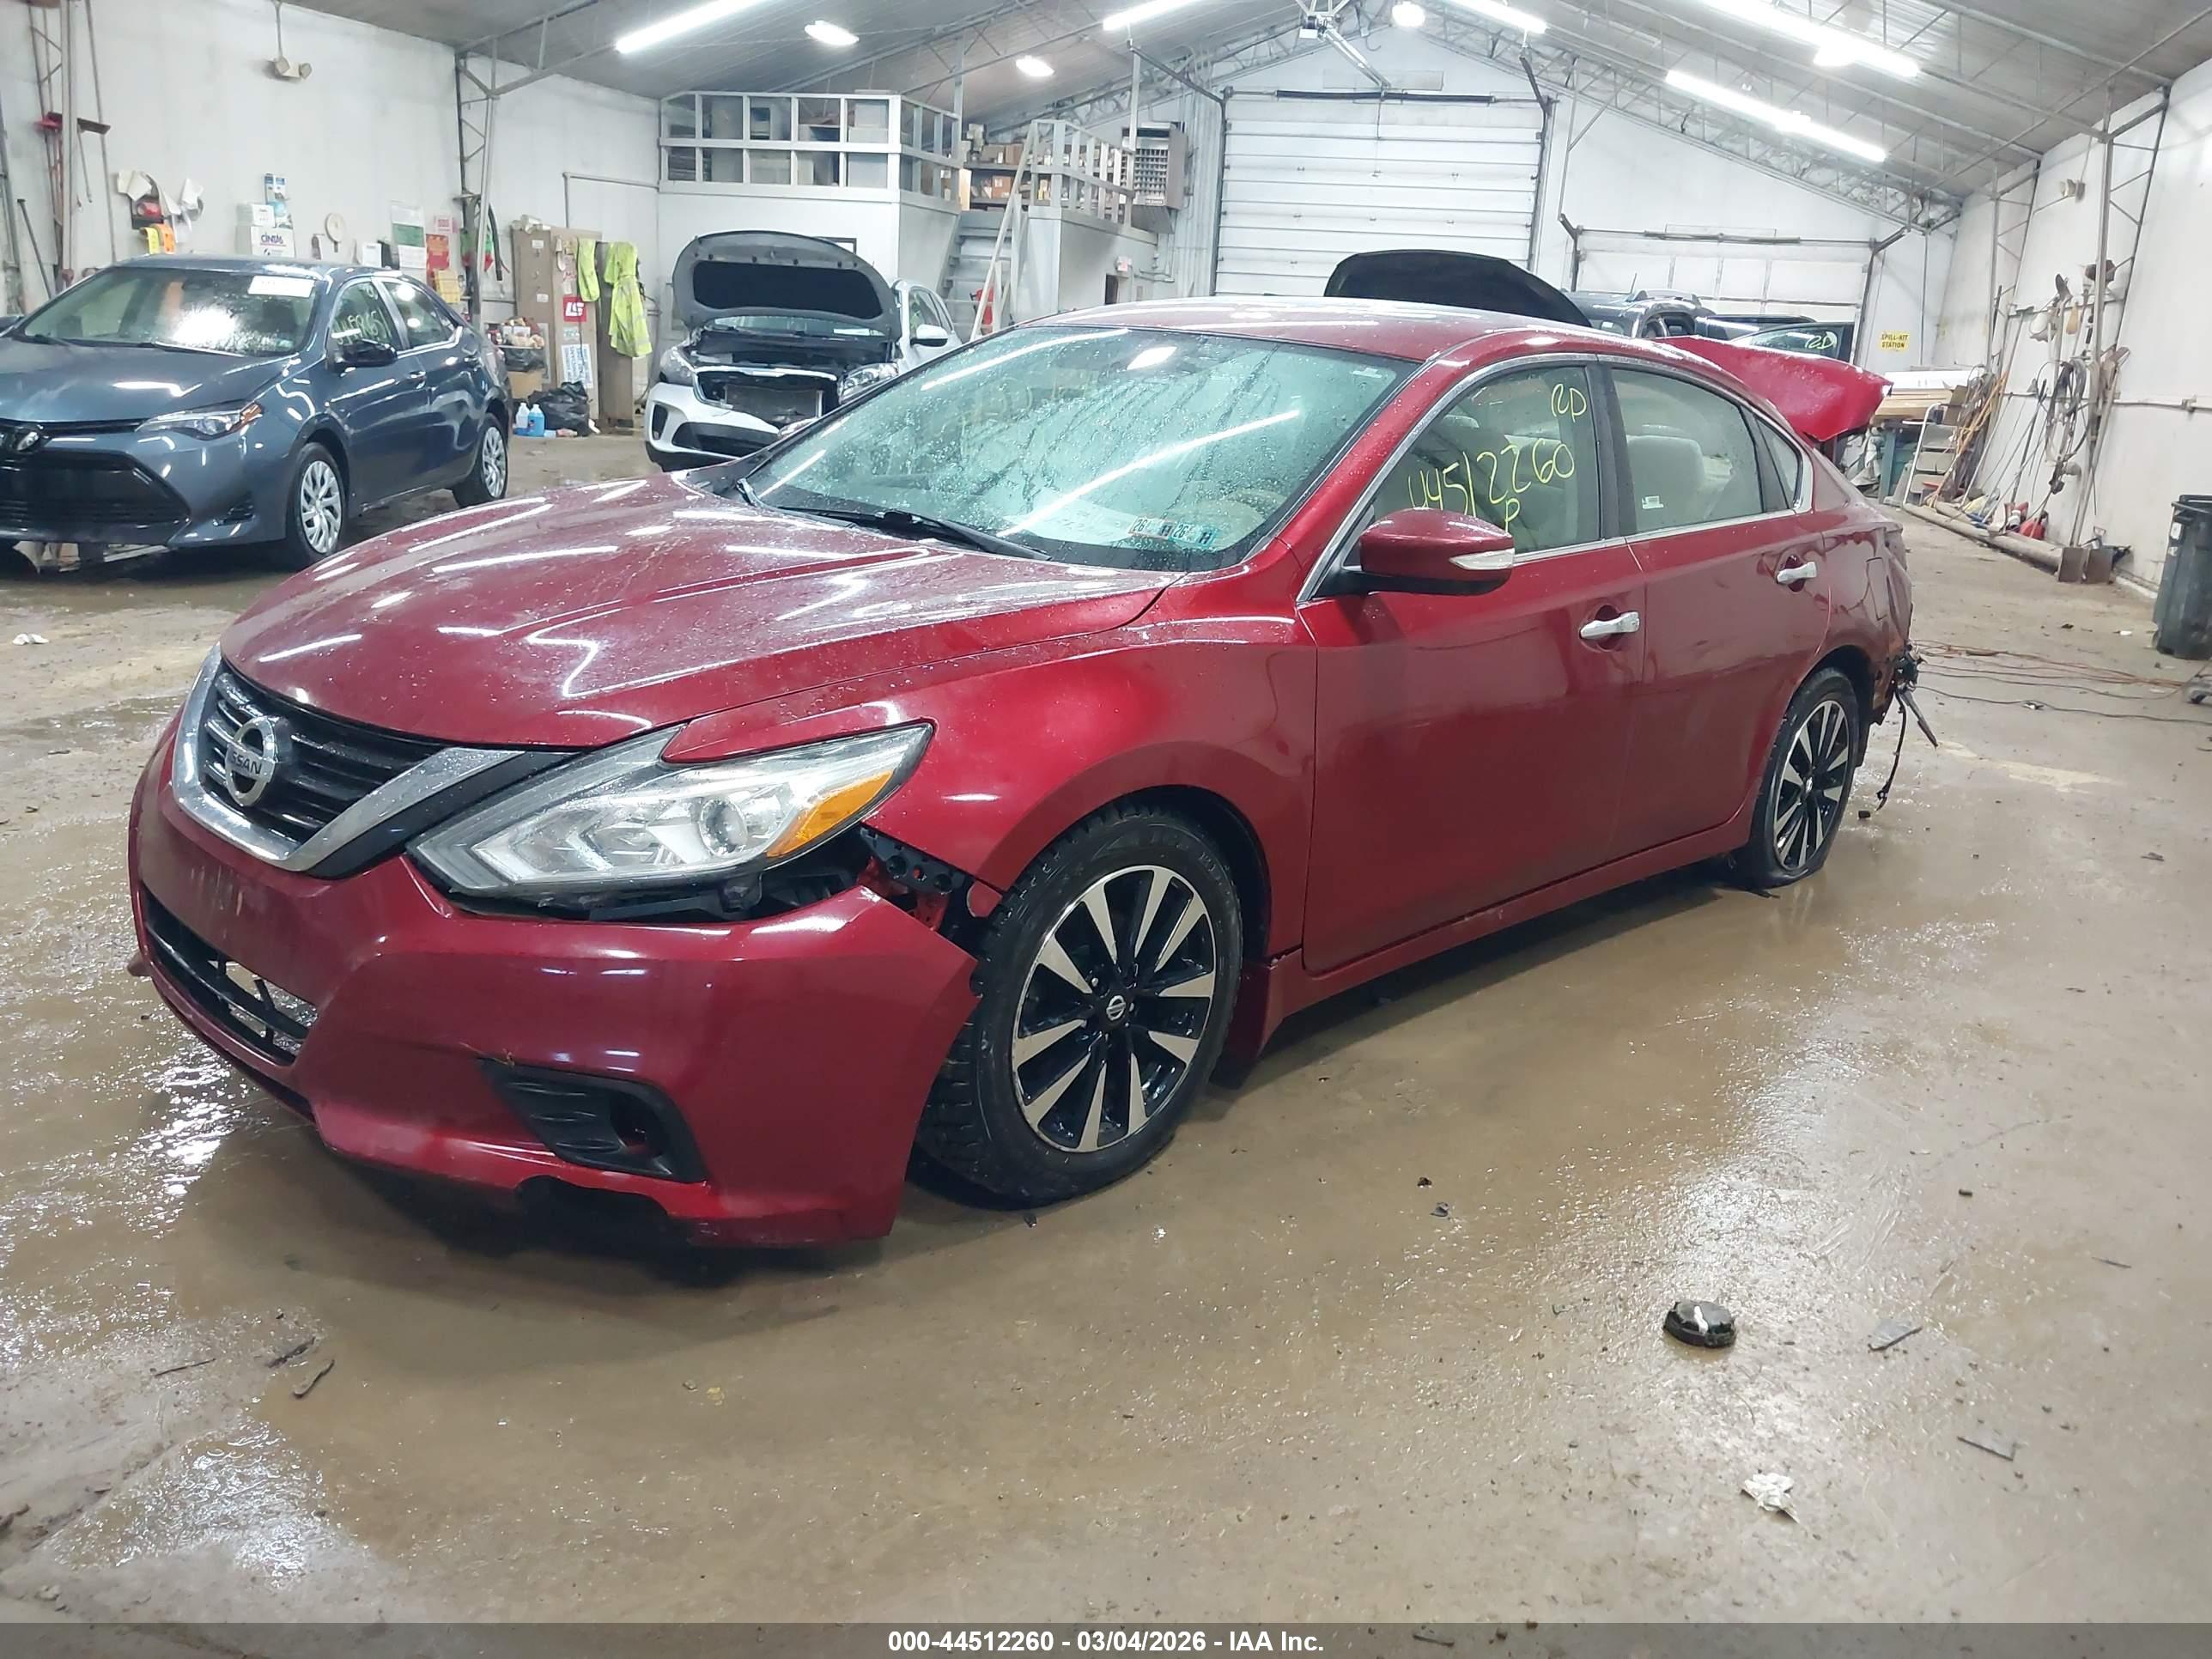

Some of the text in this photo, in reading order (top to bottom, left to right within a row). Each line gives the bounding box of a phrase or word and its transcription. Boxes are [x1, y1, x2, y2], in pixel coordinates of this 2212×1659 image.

[1552, 384, 1587, 422] RD
[1133, 519, 1147, 532] 26
[1172, 524, 1189, 538] 26
[228, 751, 263, 775] SSAN
